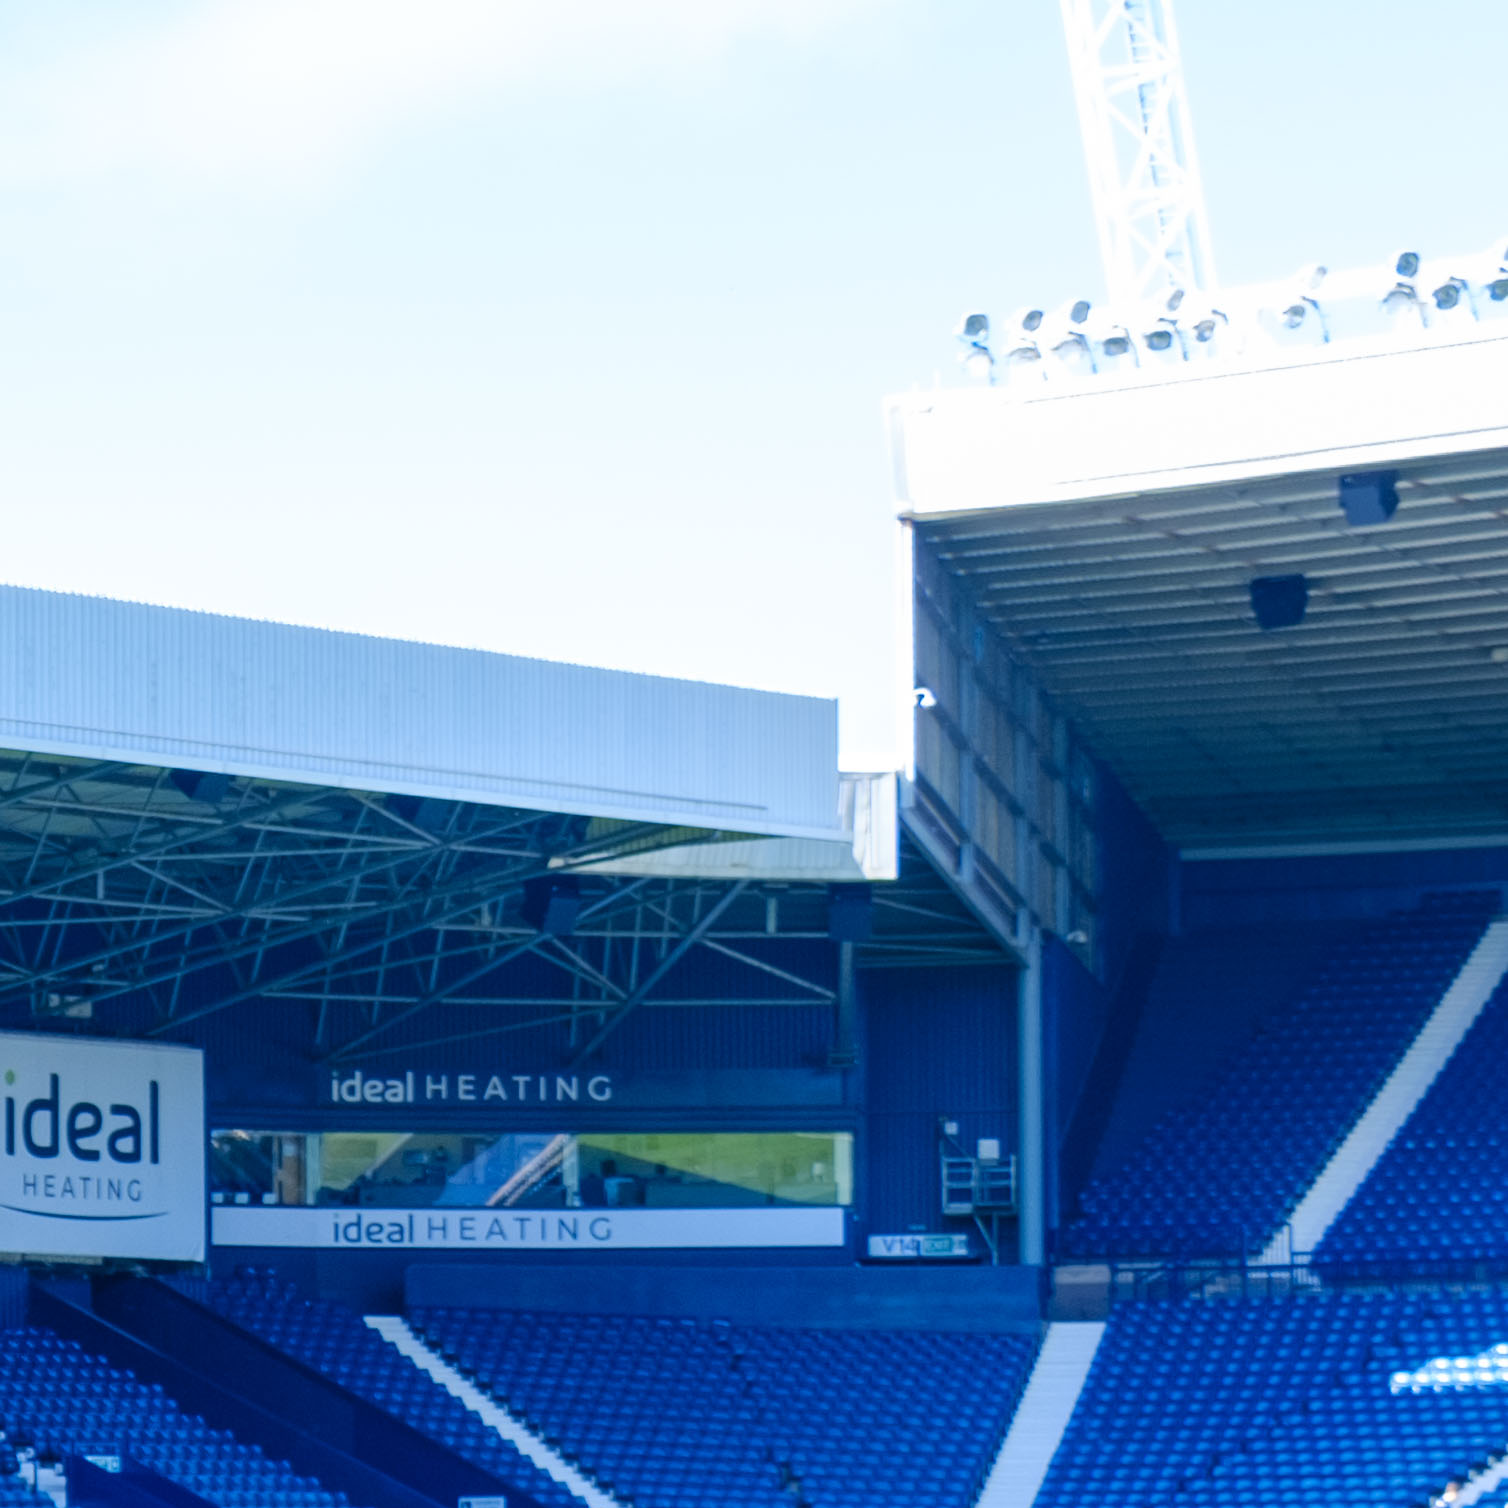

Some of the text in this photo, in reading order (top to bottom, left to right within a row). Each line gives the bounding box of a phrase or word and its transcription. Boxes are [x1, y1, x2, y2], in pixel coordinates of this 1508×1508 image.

[331, 1071, 613, 1103] ideal HEATING
[5, 1069, 159, 1164] ideal
[22, 1173, 142, 1202] HEATING
[333, 1214, 613, 1244] ideal HEATING
